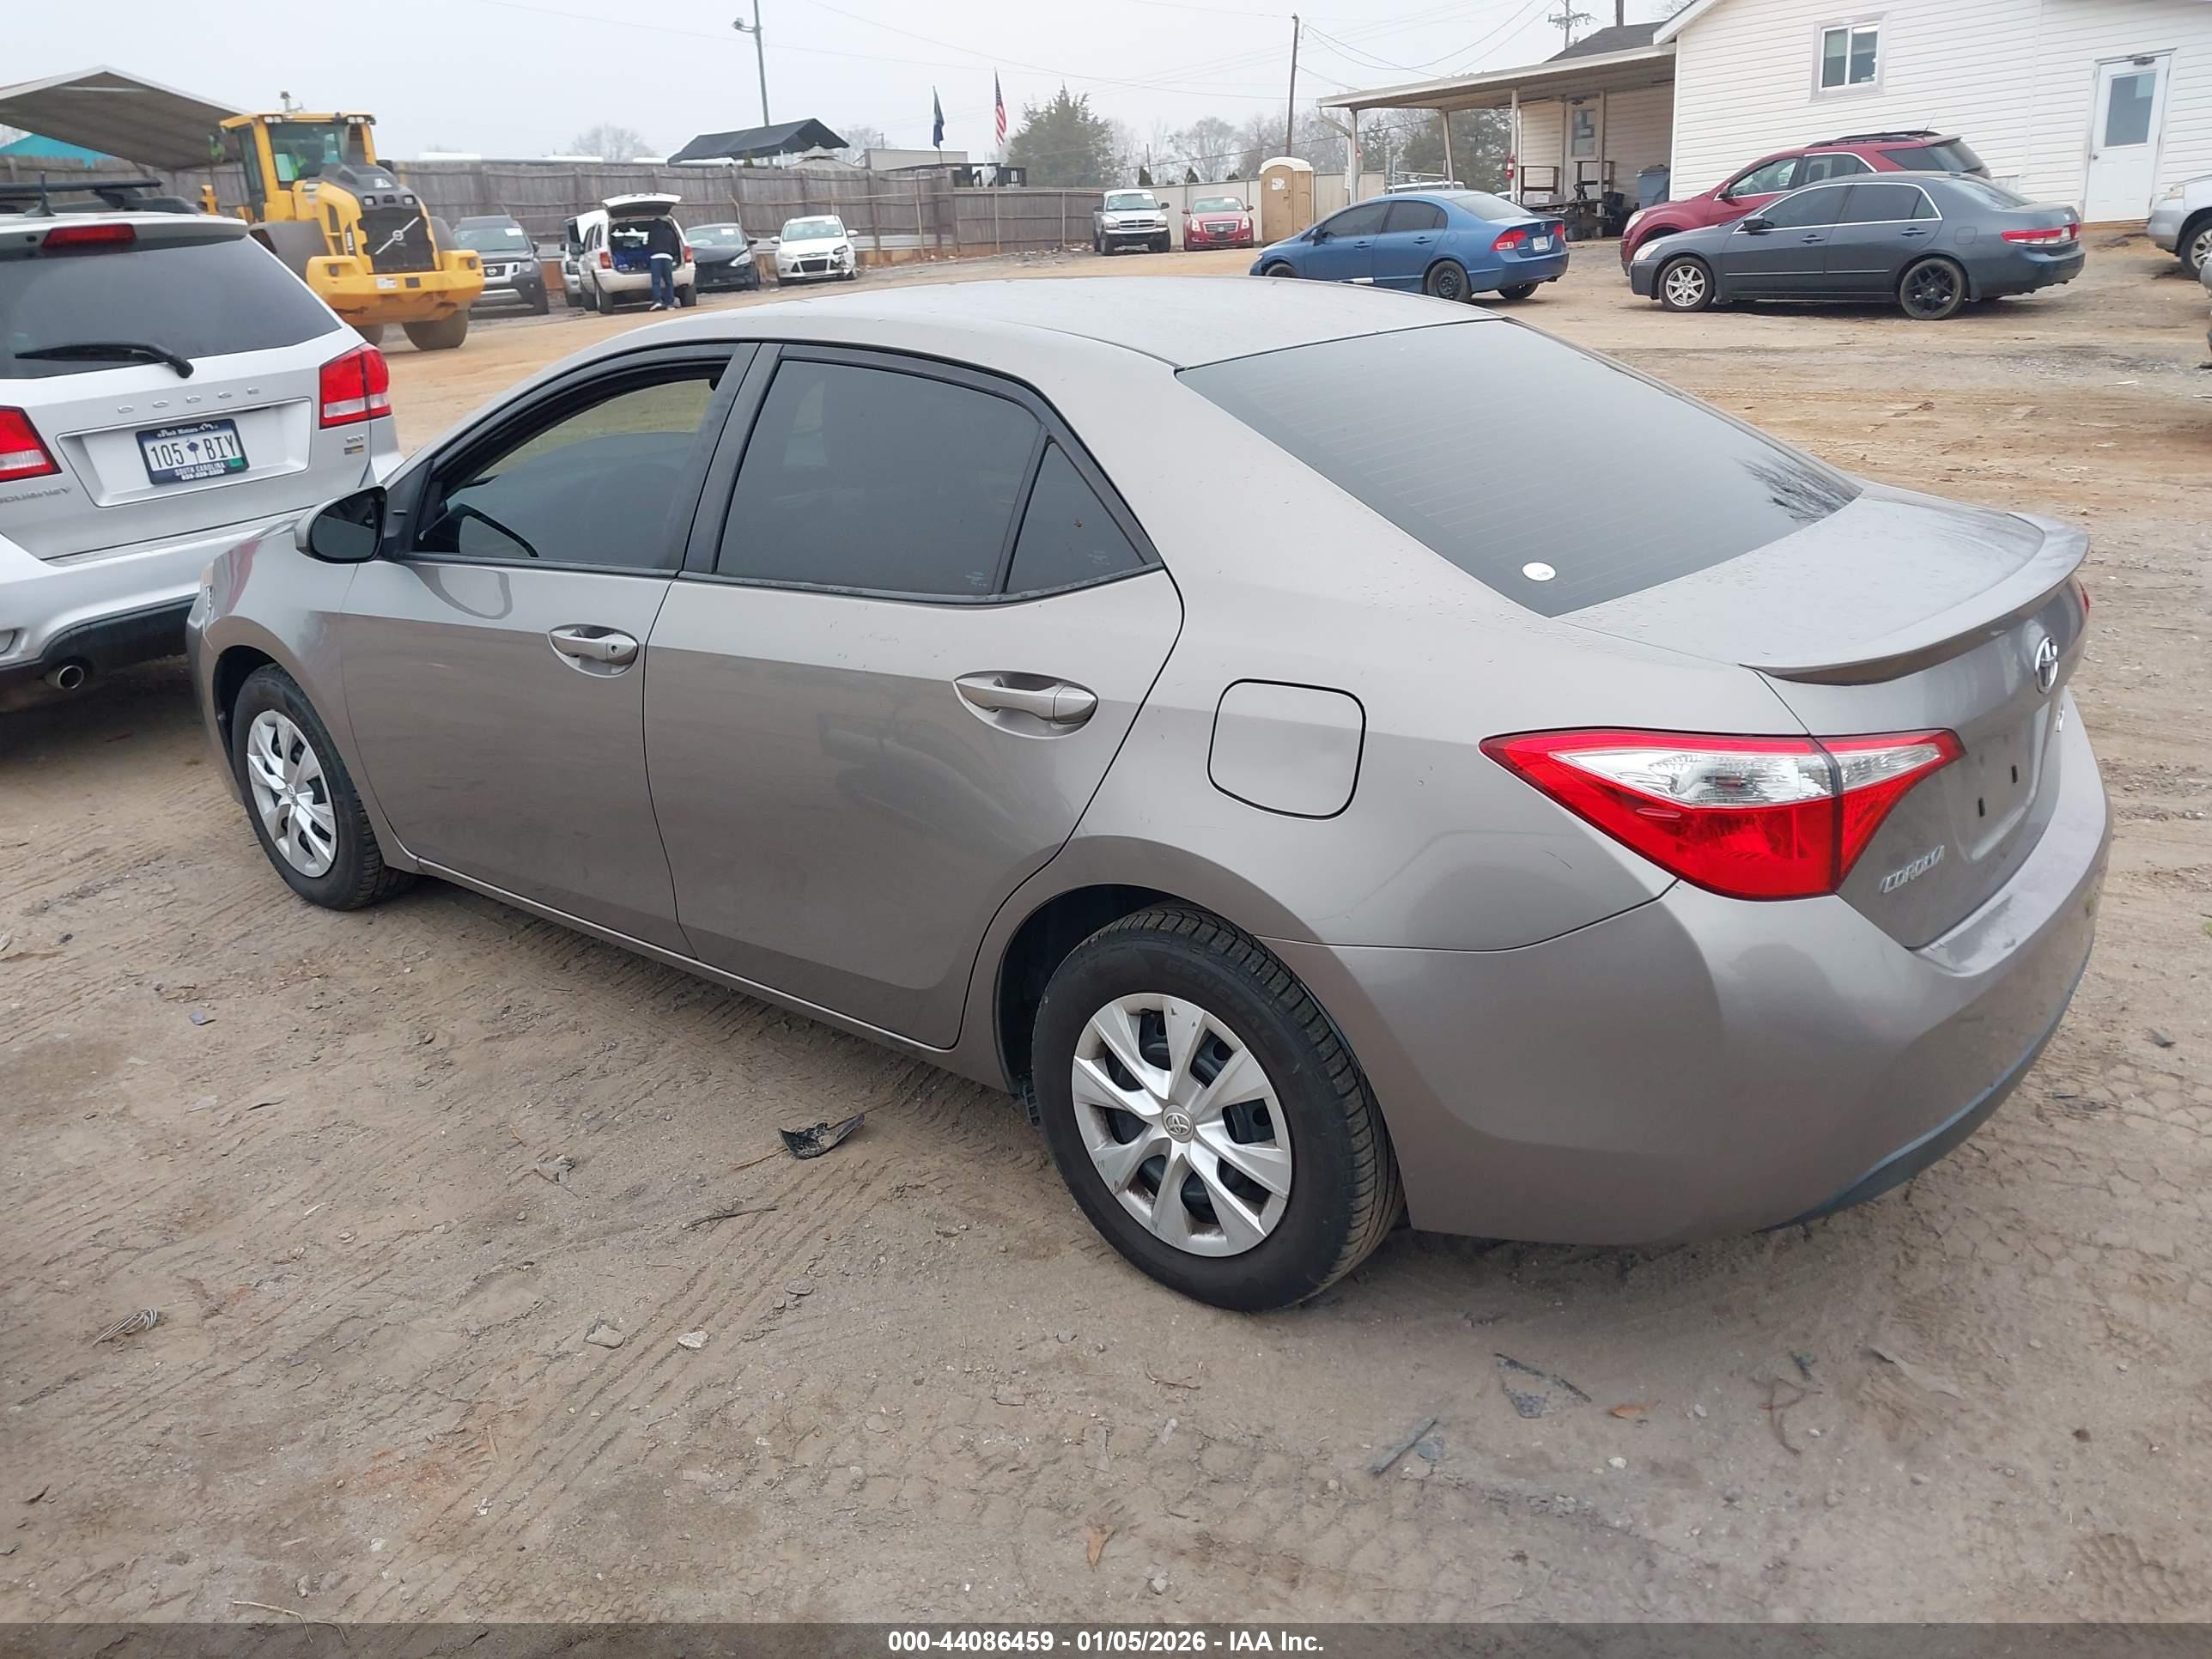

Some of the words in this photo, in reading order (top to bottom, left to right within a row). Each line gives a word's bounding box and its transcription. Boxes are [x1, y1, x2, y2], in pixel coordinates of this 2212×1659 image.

[117, 386, 260, 414] DODGE
[150, 442, 185, 469] 105
[203, 434, 237, 460] BIY
